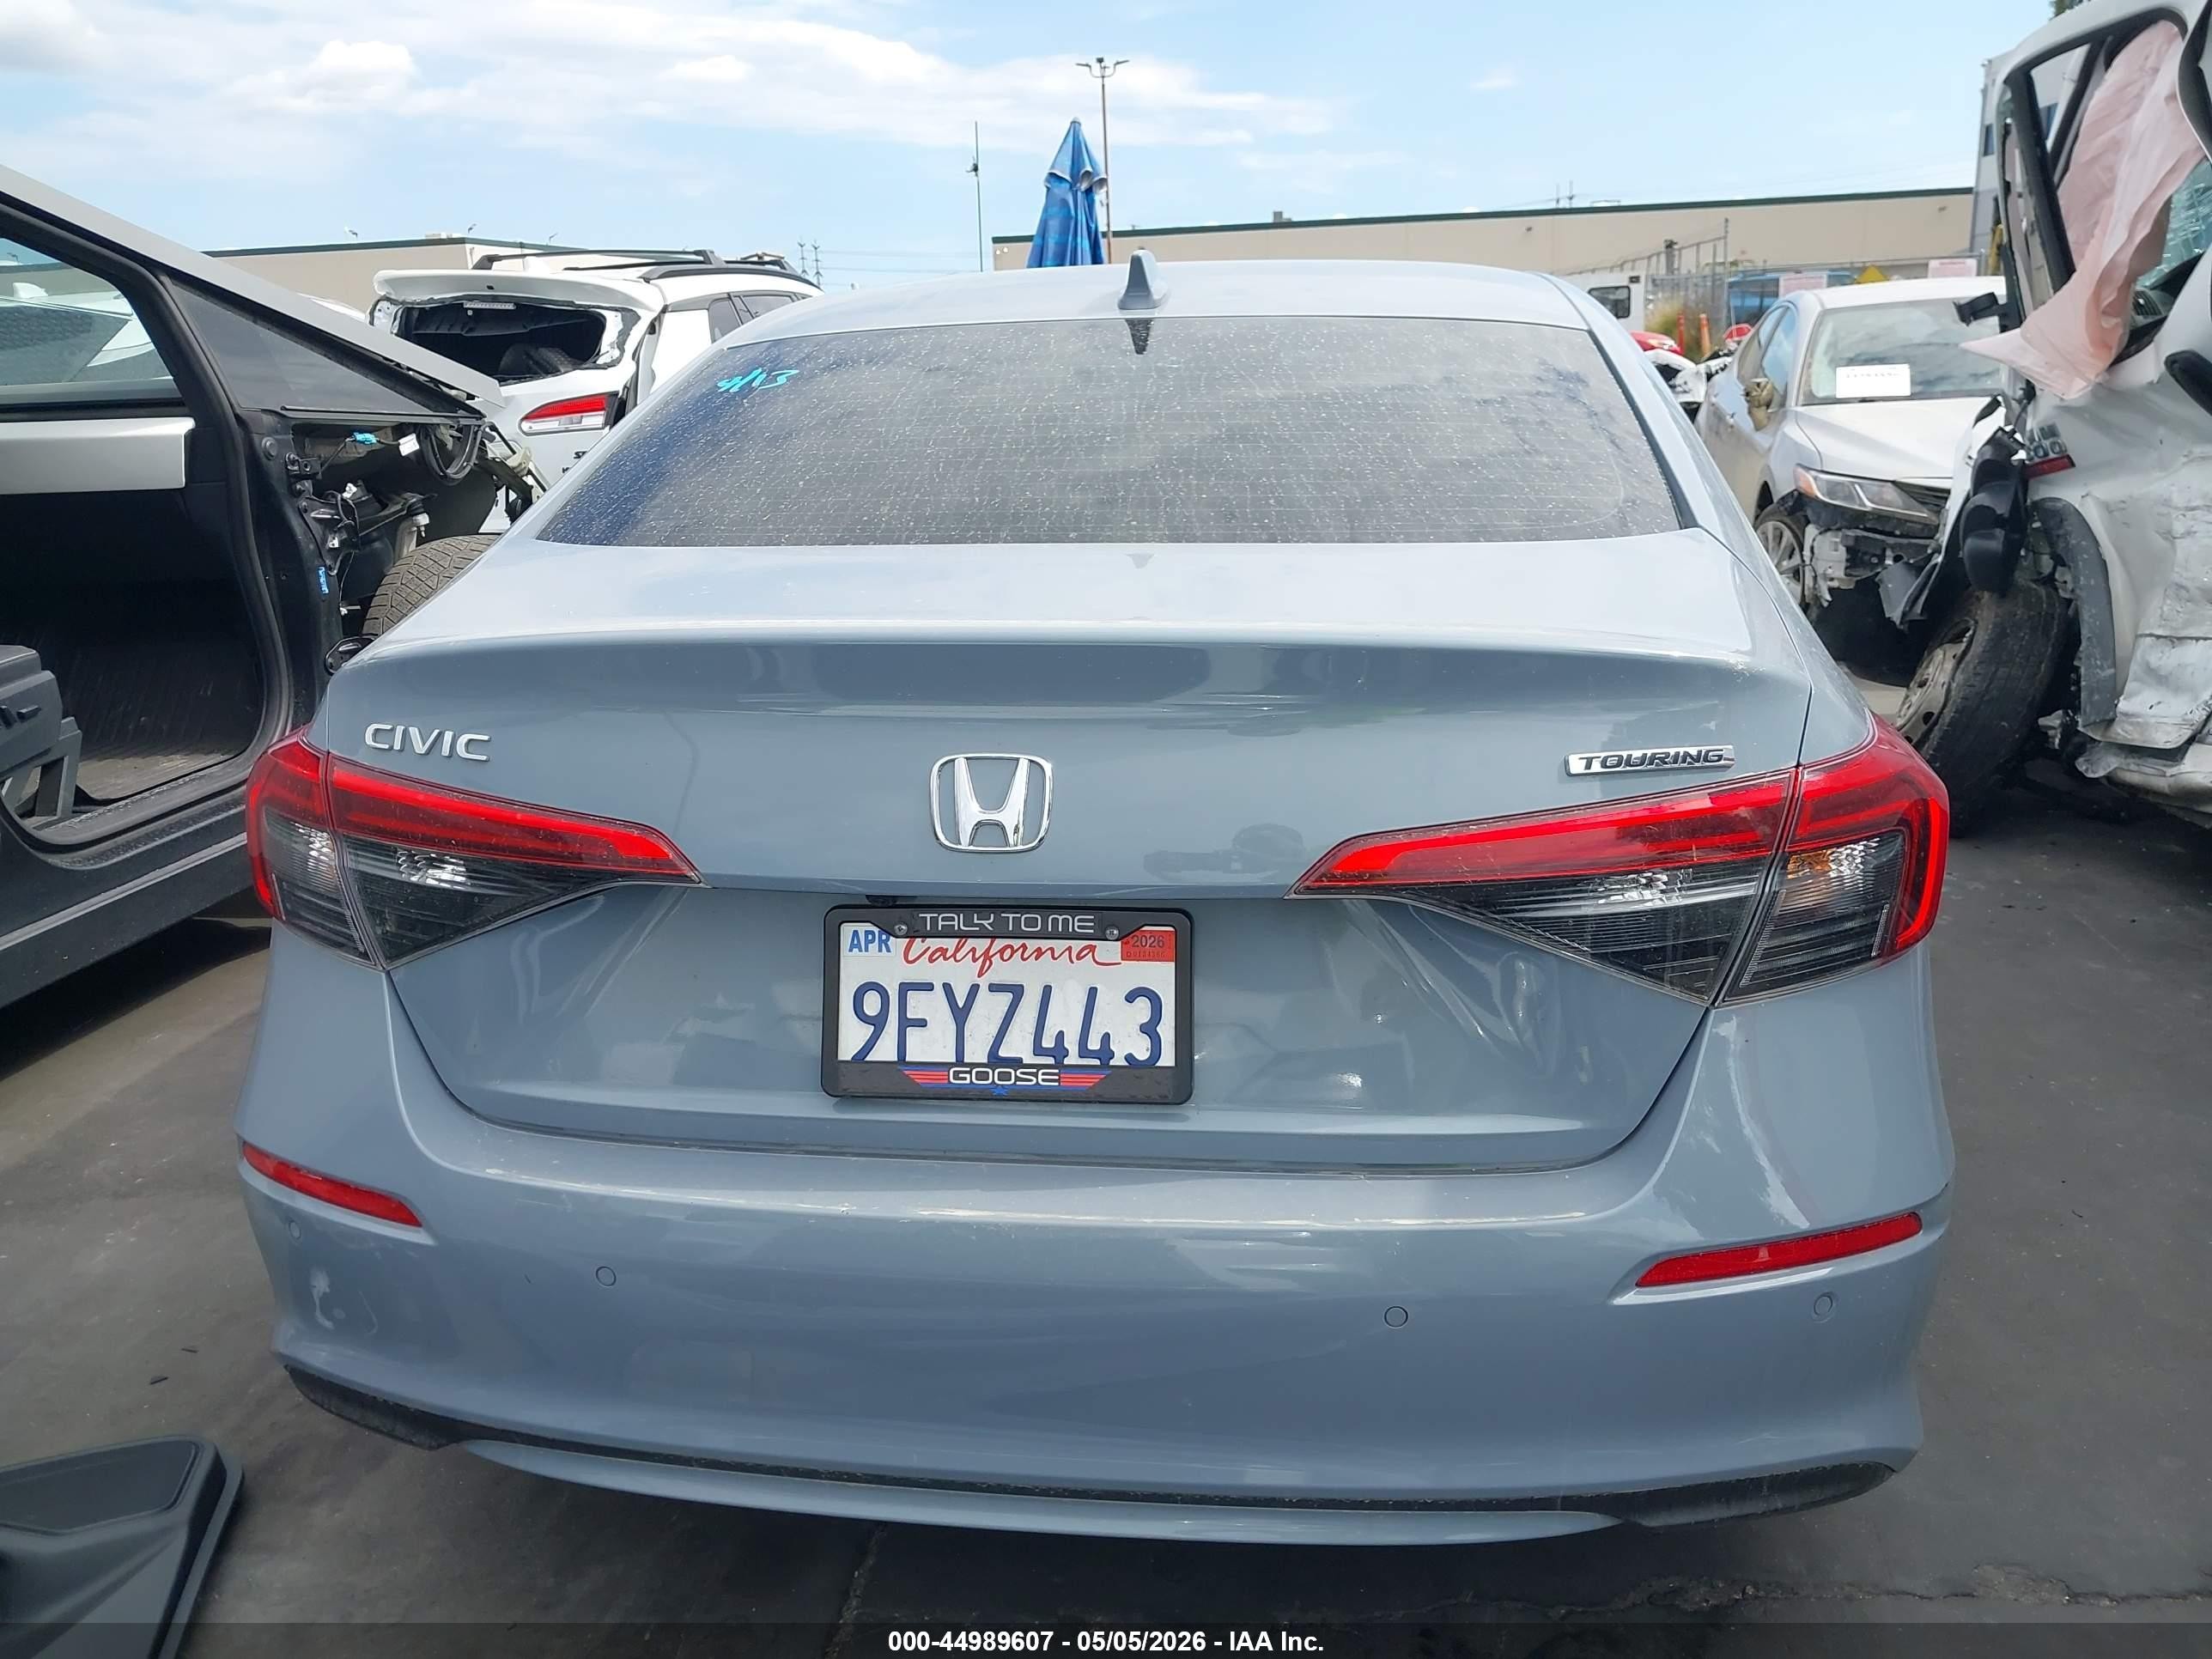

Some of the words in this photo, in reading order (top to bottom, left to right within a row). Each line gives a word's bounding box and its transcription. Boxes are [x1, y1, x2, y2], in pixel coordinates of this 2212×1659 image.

[364, 723, 491, 762] CIVIC
[1578, 749, 1724, 771] TOURING
[918, 913, 994, 932] TALK
[1000, 914, 1042, 933] TO
[1048, 915, 1095, 933] ME
[848, 929, 892, 953] APR
[1132, 934, 1164, 948] 2026
[902, 936, 1121, 978] California
[850, 981, 1163, 1066] 9FYZ443
[949, 1066, 1060, 1086] GOOSE
